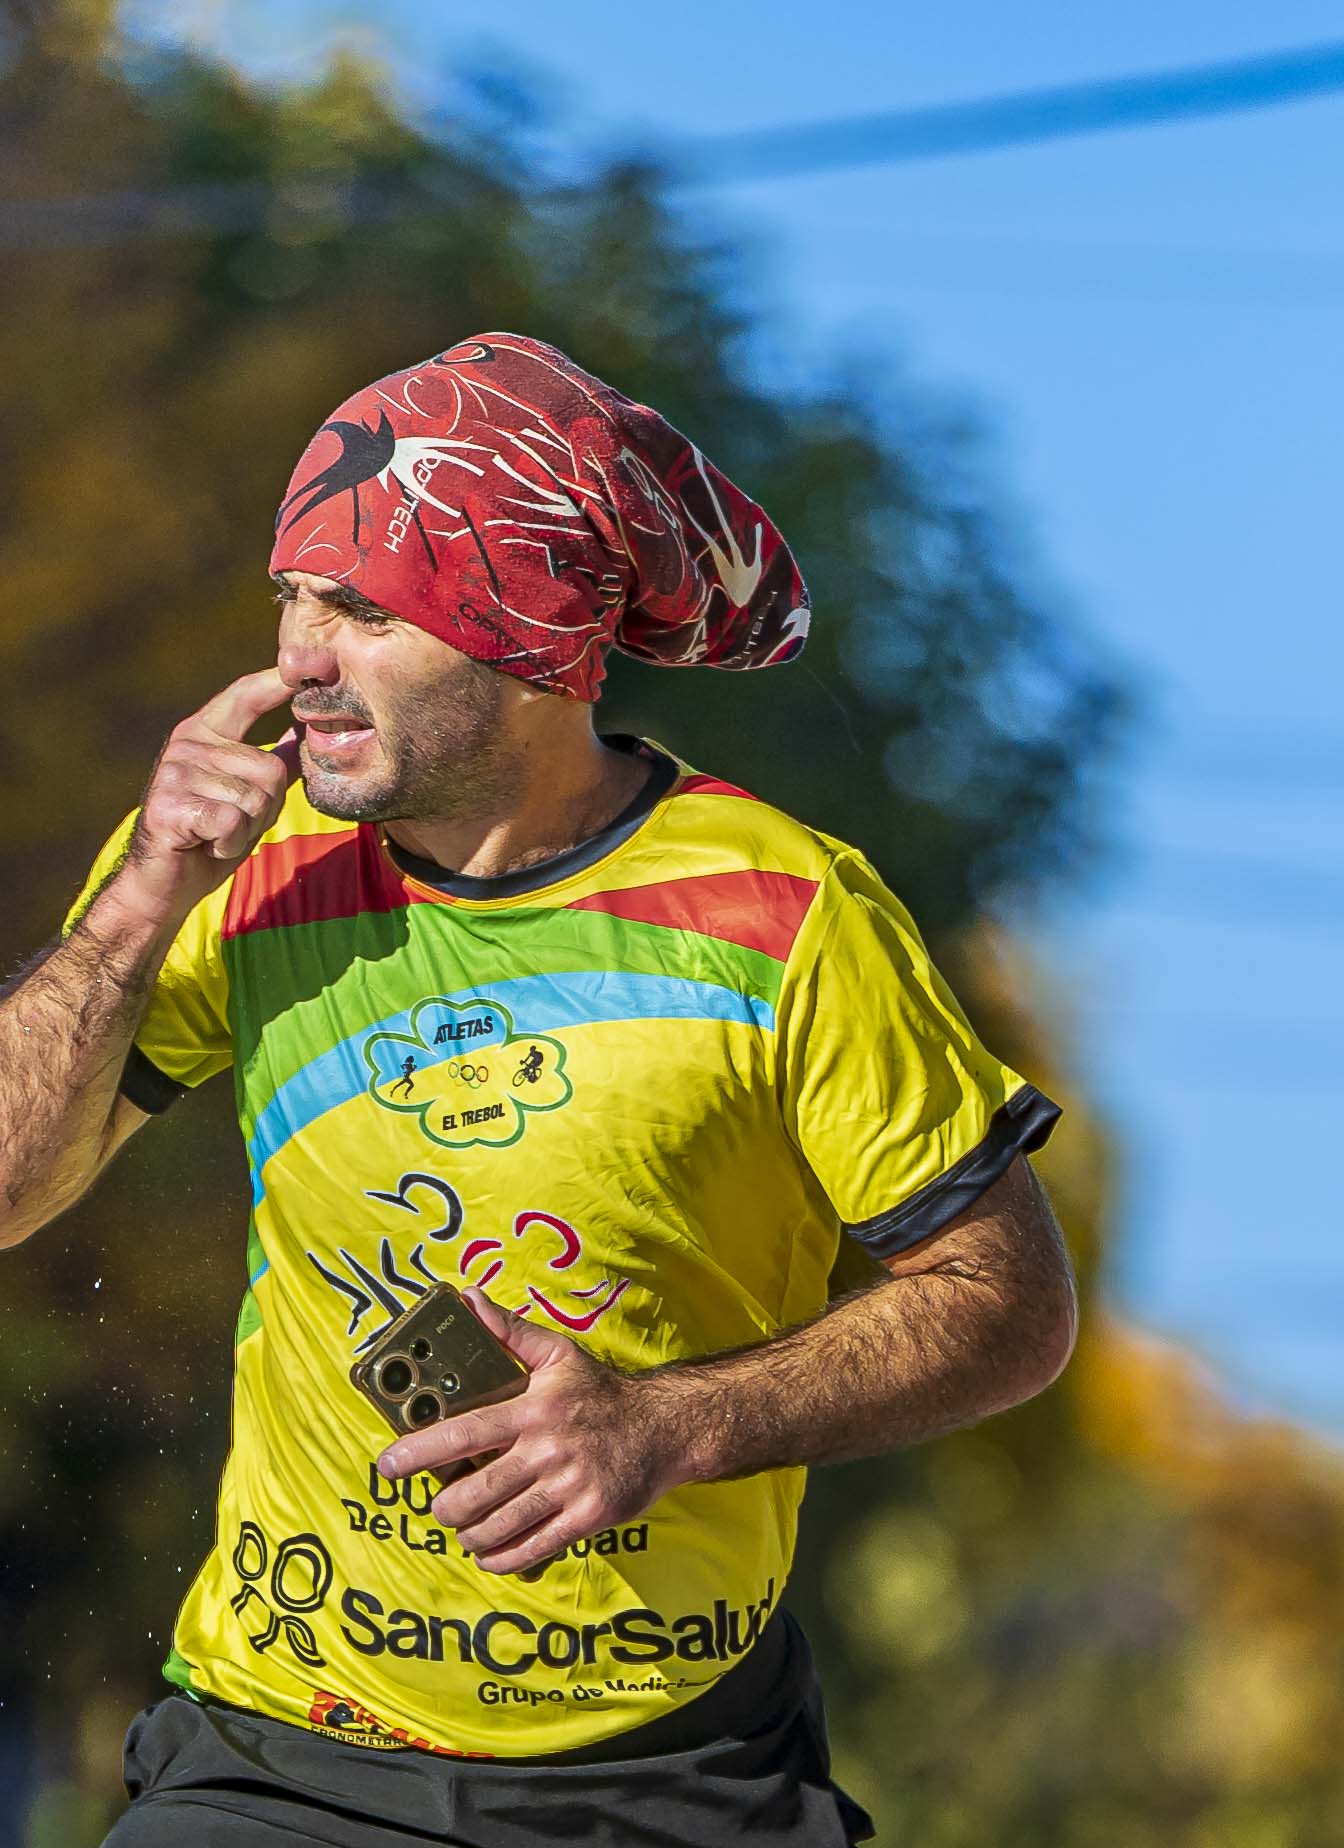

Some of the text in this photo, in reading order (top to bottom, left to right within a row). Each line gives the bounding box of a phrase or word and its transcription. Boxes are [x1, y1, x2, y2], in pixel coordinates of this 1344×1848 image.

[434, 1015, 494, 1045] ATLETAS
[442, 1103, 506, 1131] EL TREBOL
[436, 1314, 455, 1335] POCO
[340, 1498, 393, 1541] De
[400, 1514, 447, 1555] La
[340, 1577, 775, 1676] SanCorSalud
[478, 1681, 565, 1707] Grupo
